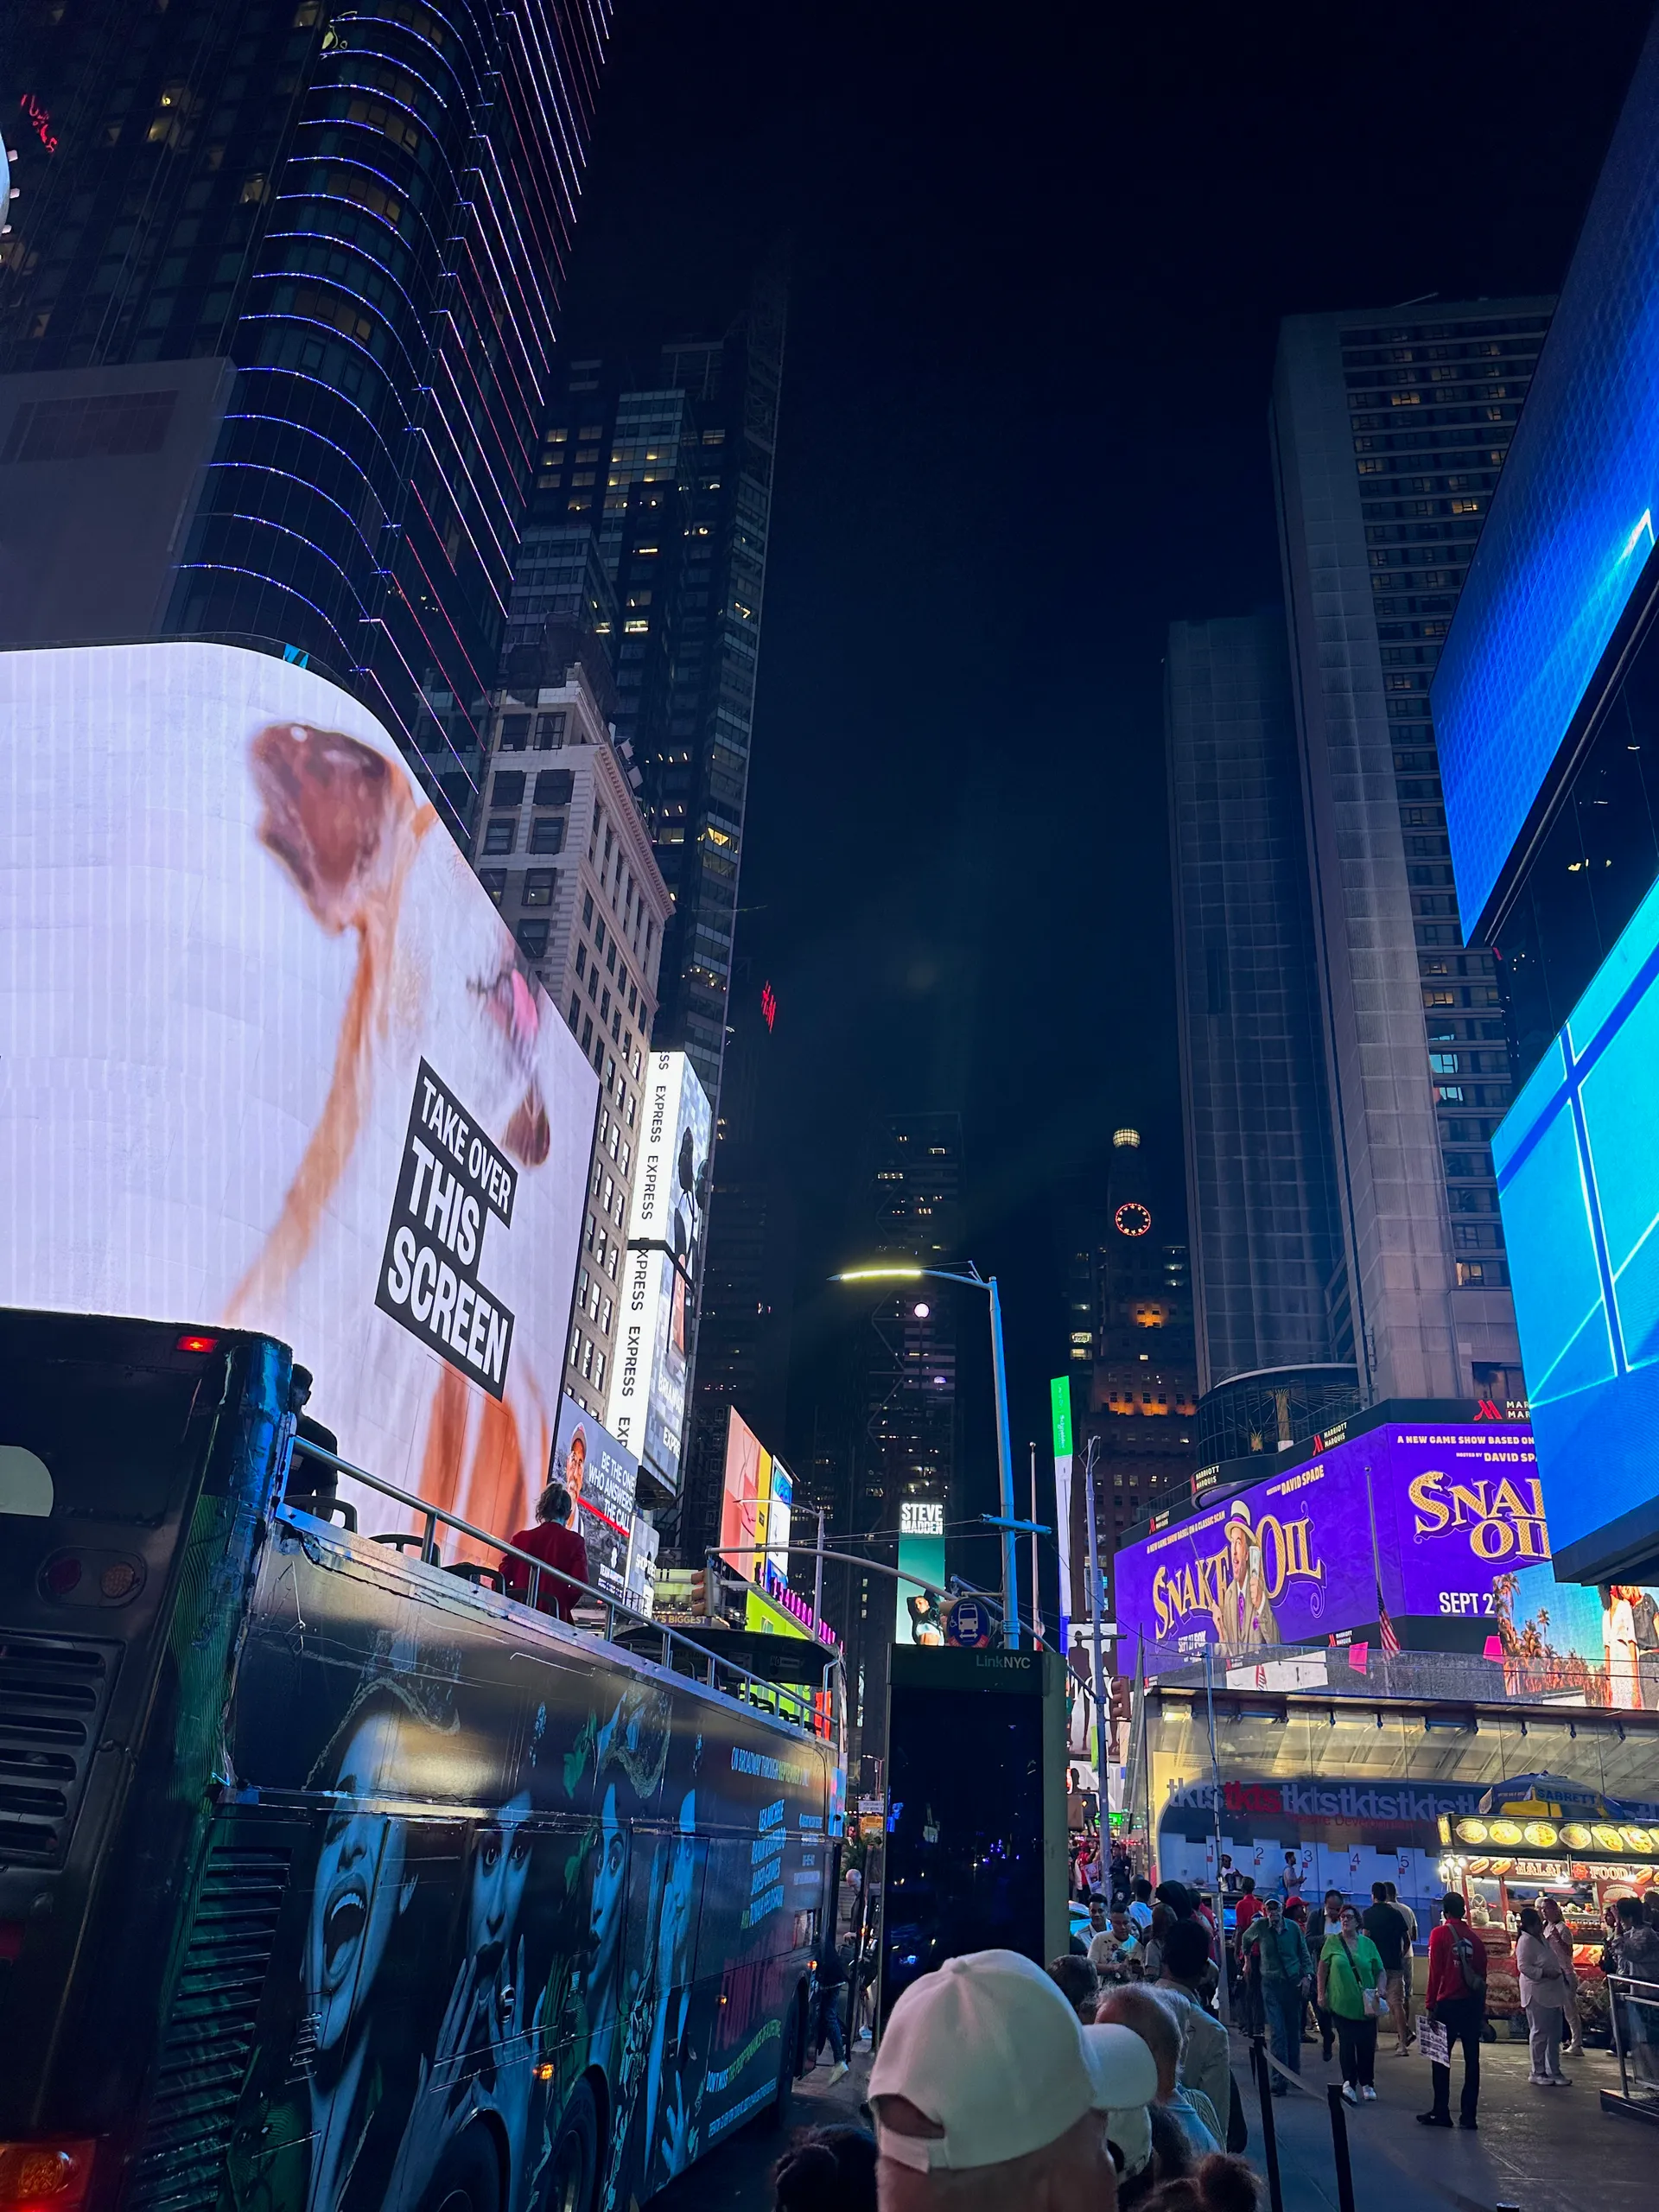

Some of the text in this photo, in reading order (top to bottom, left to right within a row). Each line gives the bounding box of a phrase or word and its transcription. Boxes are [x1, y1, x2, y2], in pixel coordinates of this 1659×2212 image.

[651, 1084, 666, 1143] EXPRESS
[420, 1077, 512, 1214] TAKE OVER
[641, 1155, 659, 1221] EXPRESS
[408, 1135, 480, 1267] THIS
[386, 1226, 509, 1384] SCREEN
[621, 1325, 640, 1397] EXPRESS
[1397, 1435, 1405, 1444] A
[1458, 1436, 1486, 1445] SHOW
[1488, 1436, 1519, 1445] BASED
[1522, 1436, 1535, 1445] ON
[1484, 1452, 1519, 1462] DAVID
[601, 1452, 636, 1493] BE THE ONE
[1281, 1475, 1301, 1496] DAVID
[1301, 1465, 1324, 1485] SPADE
[588, 1463, 632, 1512] WHO ANSWERS
[901, 1503, 944, 1522] STEVE
[1408, 1470, 1545, 1535] SNA
[604, 1497, 629, 1532] THE CALL
[901, 1521, 944, 1535] MADDEN
[1153, 1515, 1322, 1640] SNAKE OIL
[1439, 1592, 1496, 1615] SEPT 2
[668, 1616, 707, 1624] BIGGEST
[976, 1655, 1031, 1669] LinkNYC
[1224, 1780, 1281, 1813] tkts
[1537, 1789, 1597, 1805] SABRETT
[1209, 1845, 1214, 1856] 1
[1255, 1847, 1264, 1859] 2
[1304, 1850, 1313, 1863] 3
[1351, 1853, 1361, 1865] 4
[1401, 1856, 1409, 1868] 5
[1516, 1861, 1561, 1877] HALAL
[1589, 1867, 1630, 1881] FOOD
